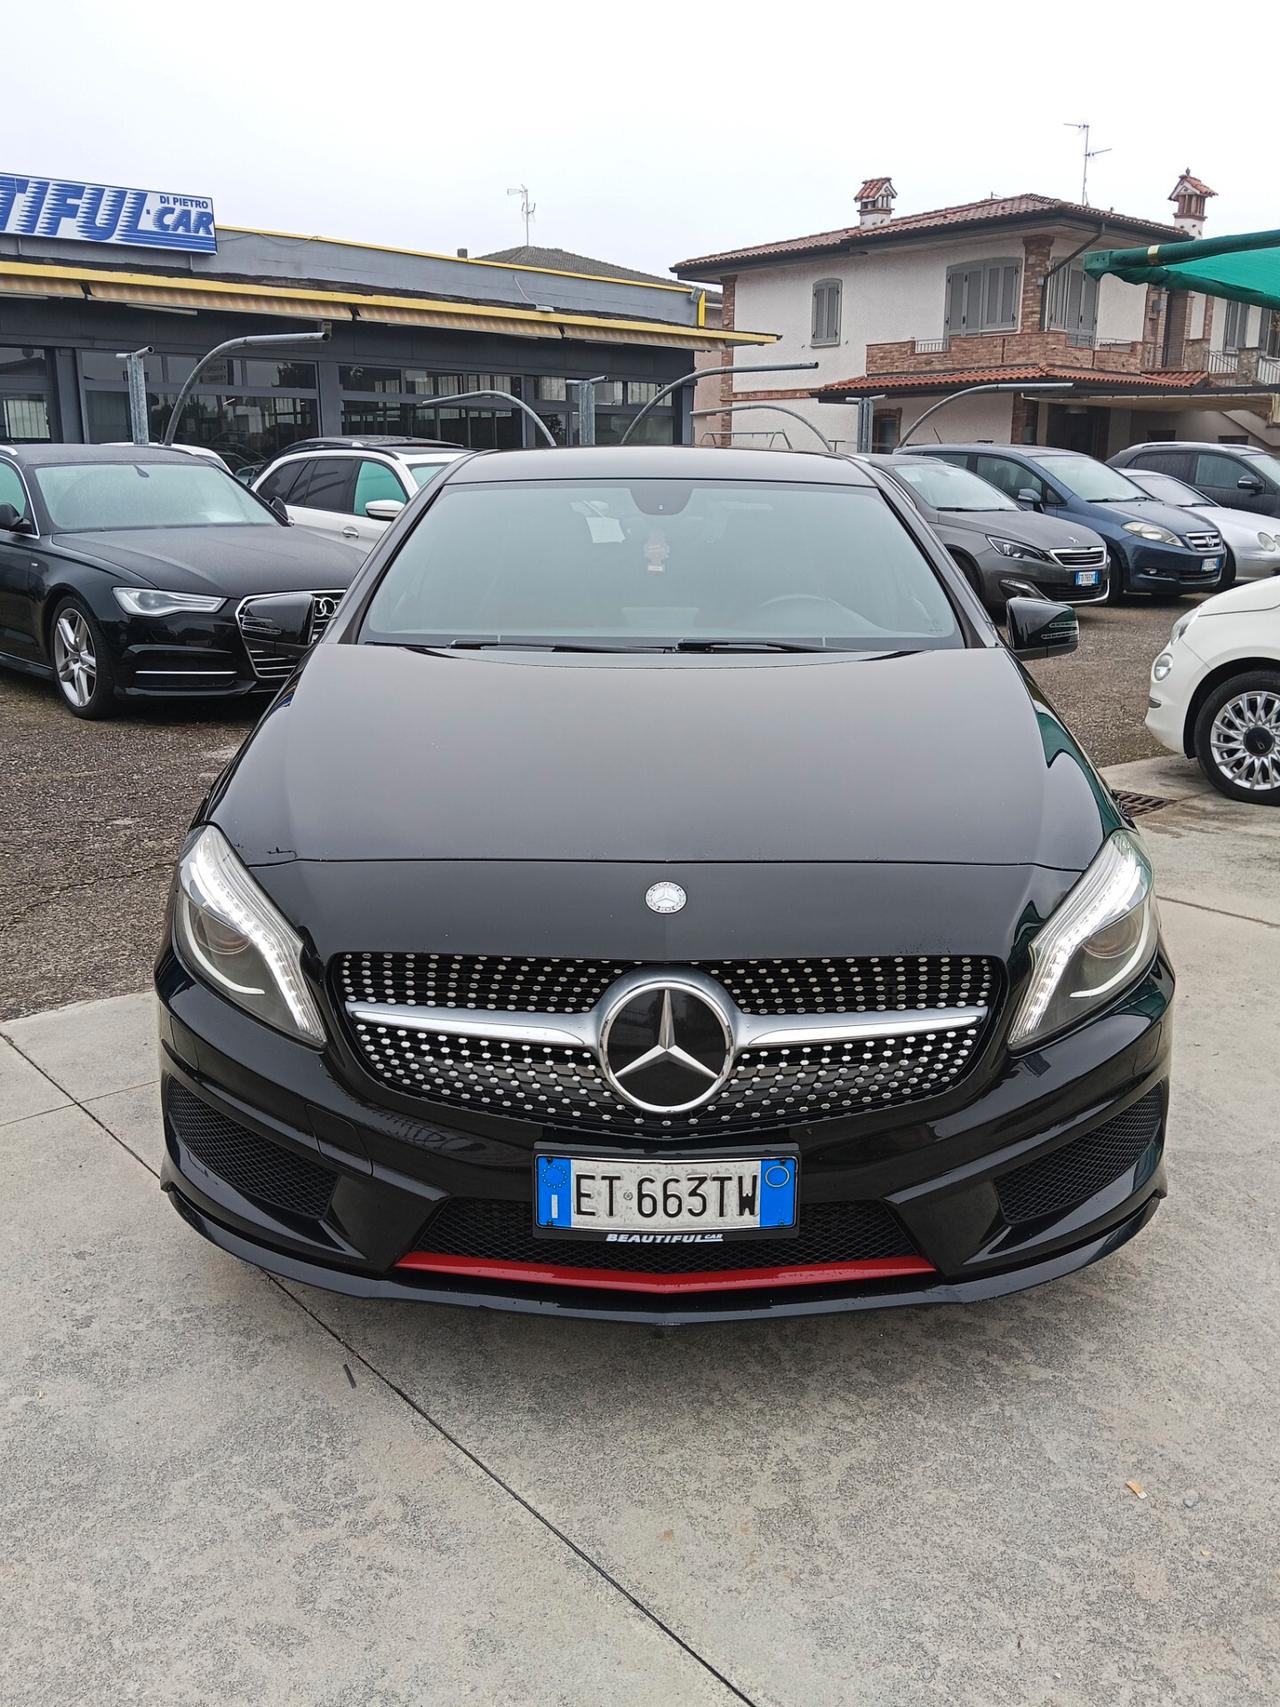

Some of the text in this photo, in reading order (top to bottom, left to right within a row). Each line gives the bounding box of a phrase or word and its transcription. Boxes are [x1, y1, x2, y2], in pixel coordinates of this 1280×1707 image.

[159, 195, 209, 209] DI PIETRO
[152, 206, 213, 236] CAR
[606, 1233, 703, 1244] BEAUTIFUL
